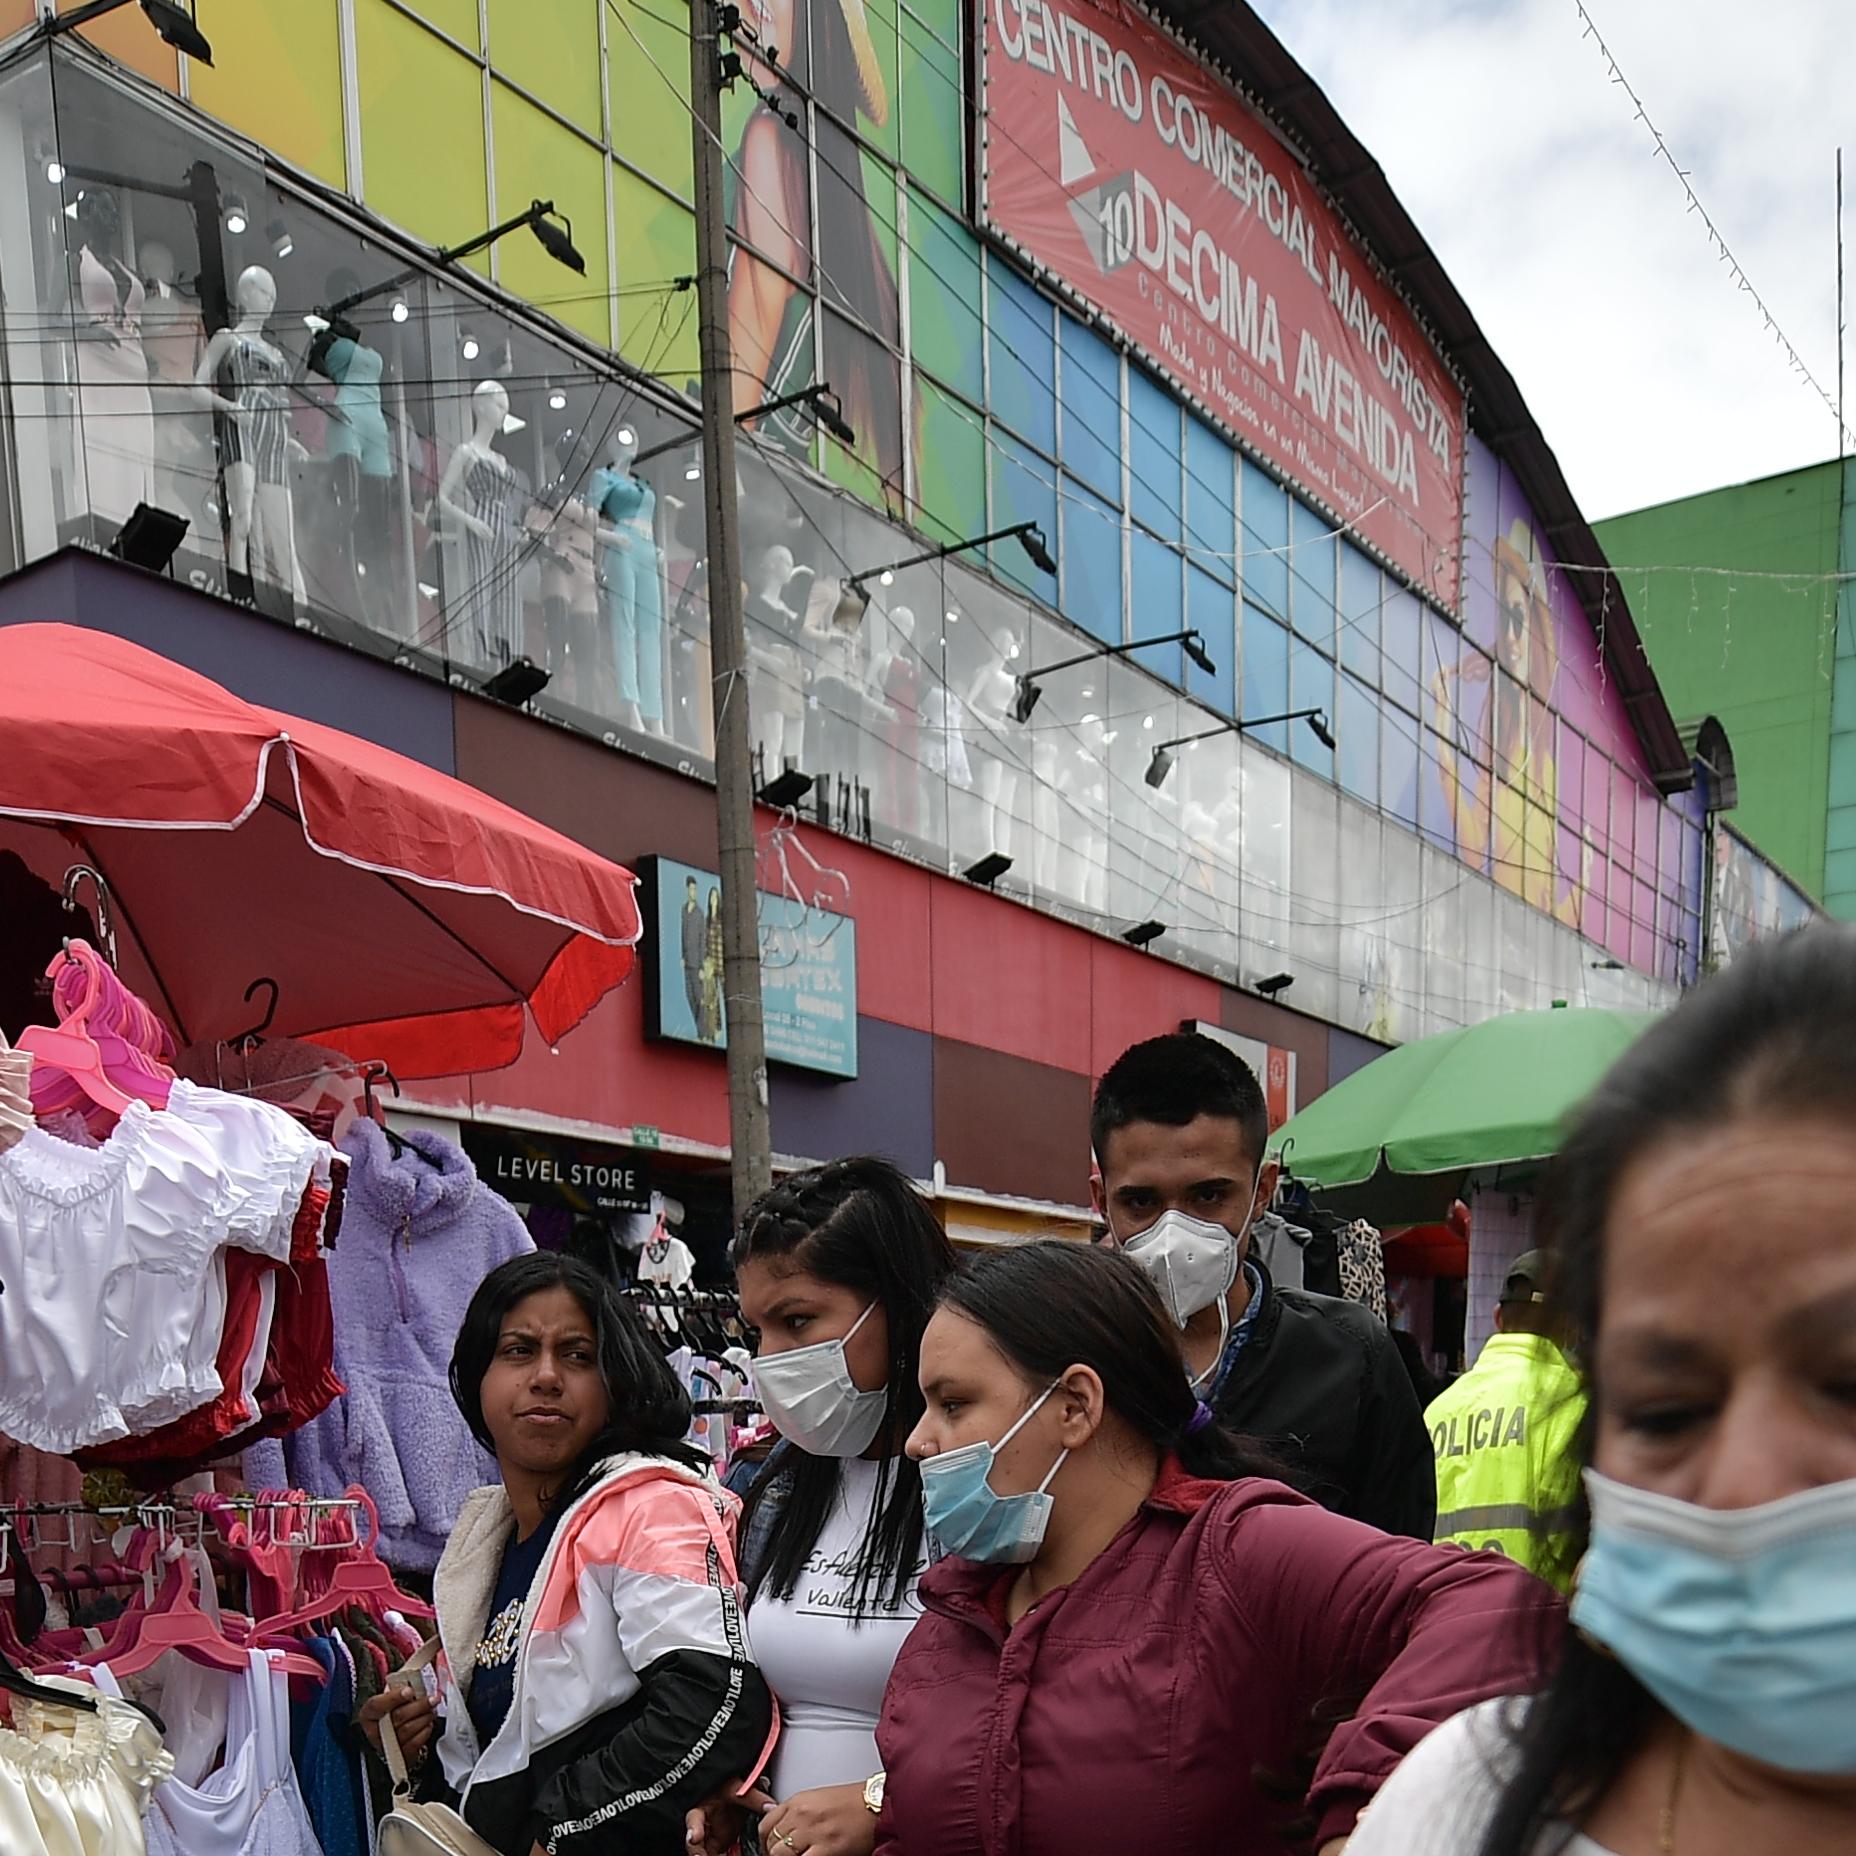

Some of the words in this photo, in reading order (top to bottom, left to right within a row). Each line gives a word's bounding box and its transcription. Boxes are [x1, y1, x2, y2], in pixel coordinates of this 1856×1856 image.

[994, 0, 1144, 124] CENTRO
[1150, 75, 1324, 289] COMERCIAL
[1328, 251, 1450, 473] MAYORISTA
[1098, 190, 1135, 268] 10
[1133, 168, 1286, 385] DECIMA
[1293, 327, 1420, 508] AVENIDA
[1137, 271, 1216, 357] Centro
[1227, 349, 1327, 454] Comercial
[1159, 322, 1195, 374] Moda
[1199, 366, 1209, 394] y
[1211, 365, 1260, 428] Negocios
[497, 1155, 564, 1184] LEVEL
[570, 1163, 636, 1190] STORE
[1430, 1405, 1526, 1460] OLICIA
